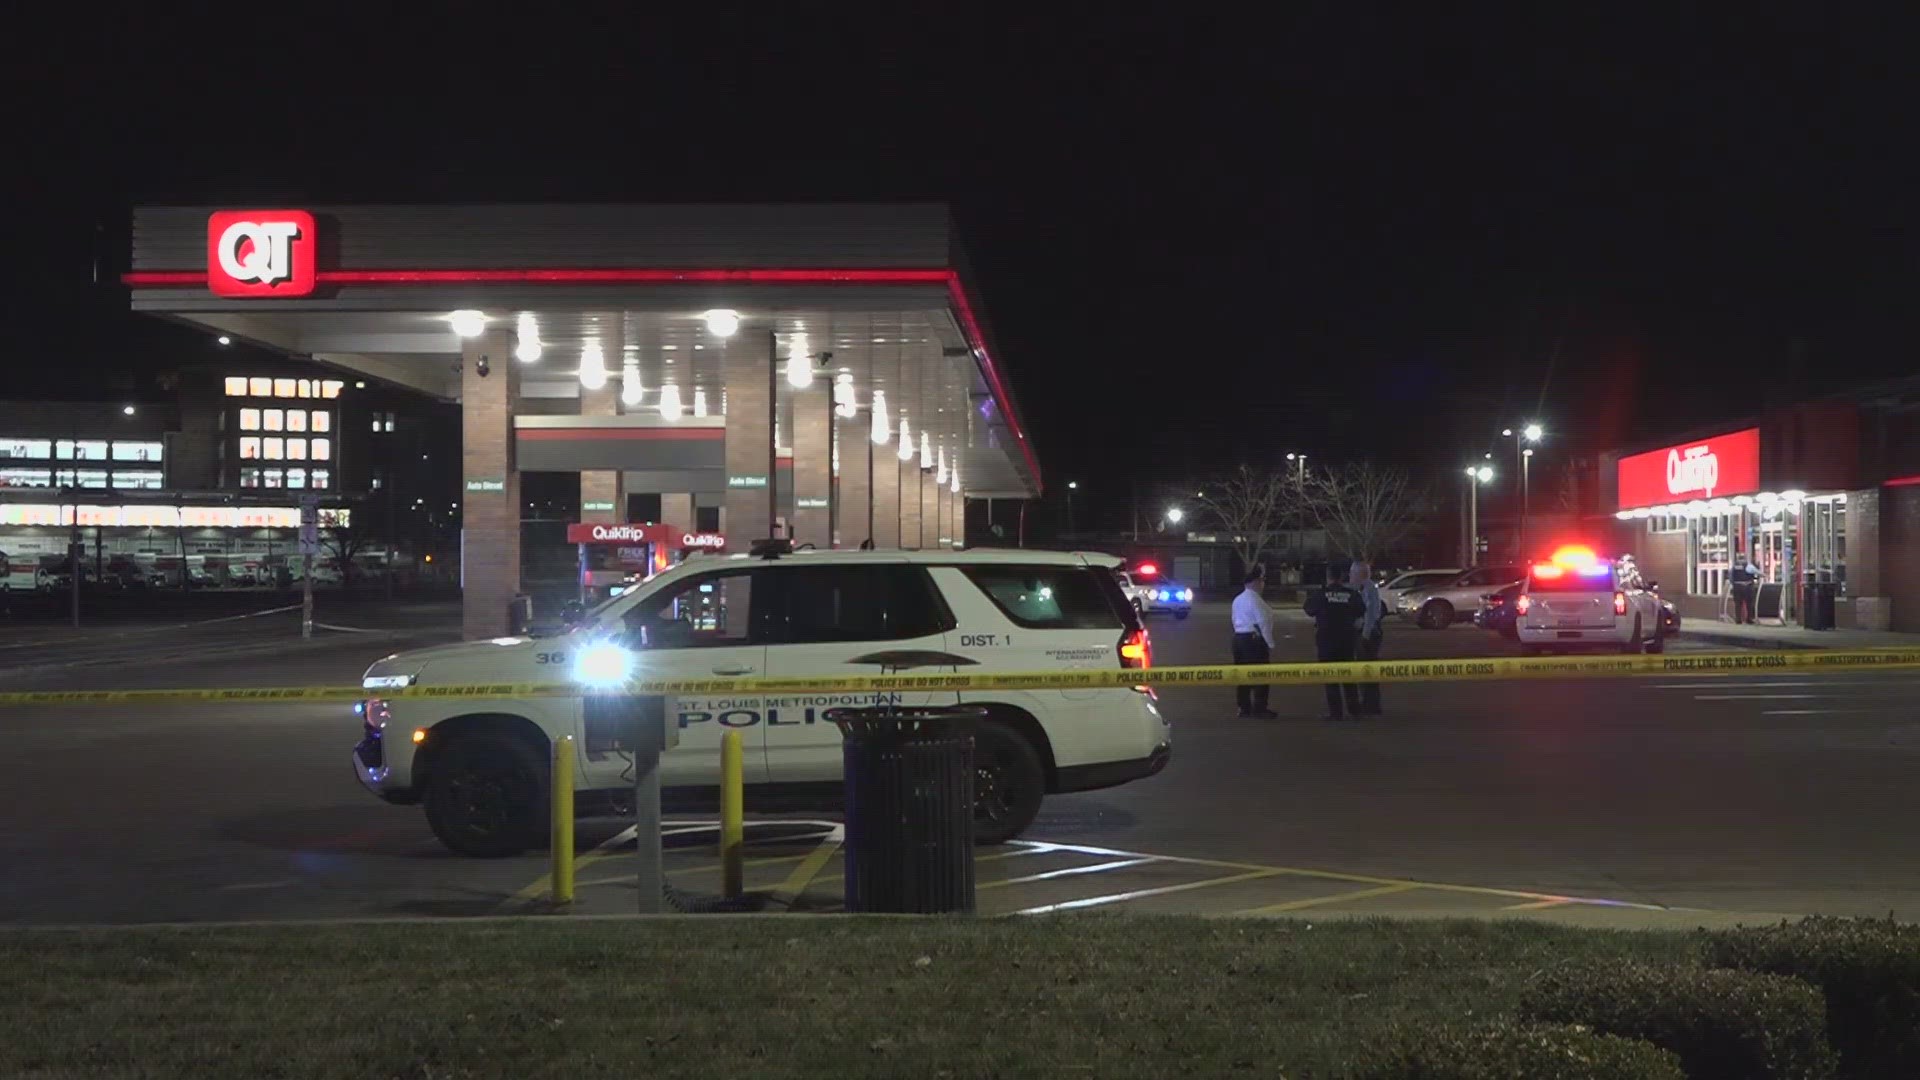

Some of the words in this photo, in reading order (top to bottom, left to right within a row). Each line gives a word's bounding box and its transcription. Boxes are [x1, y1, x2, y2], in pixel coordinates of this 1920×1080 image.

[218, 221, 297, 284] QT
[1667, 445, 1718, 498] QuikTrip
[592, 525, 644, 542] QuikTrip
[683, 533, 725, 547] QuikTrip
[961, 635, 999, 647] DIST.
[1005, 635, 1011, 646] 1
[1664, 659, 1695, 670] POLICE
[1697, 658, 1718, 669] LINE
[1720, 657, 1732, 668] DO
[1735, 656, 1753, 668] NOT
[1756, 655, 1786, 667] CROSS
[1116, 672, 1144, 683] POLICE
[1146, 671, 1164, 682] LINE
[1165, 671, 1178, 681] DO
[1178, 671, 1194, 681] NOT
[1196, 669, 1223, 680] CROSS
[1380, 666, 1409, 677] POLICE
[1411, 665, 1430, 676] LINE
[1432, 665, 1444, 675] DO
[1446, 664, 1463, 675] NOT
[1466, 663, 1494, 674] CROSS
[870, 678, 898, 687] POLICE
[900, 678, 915, 687] LINE
[916, 677, 926, 686] DO
[926, 677, 944, 686] NOT
[946, 676, 971, 686] CROSS
[708, 699, 760, 710] LOUIS
[766, 694, 902, 707] METROPOLITAN
